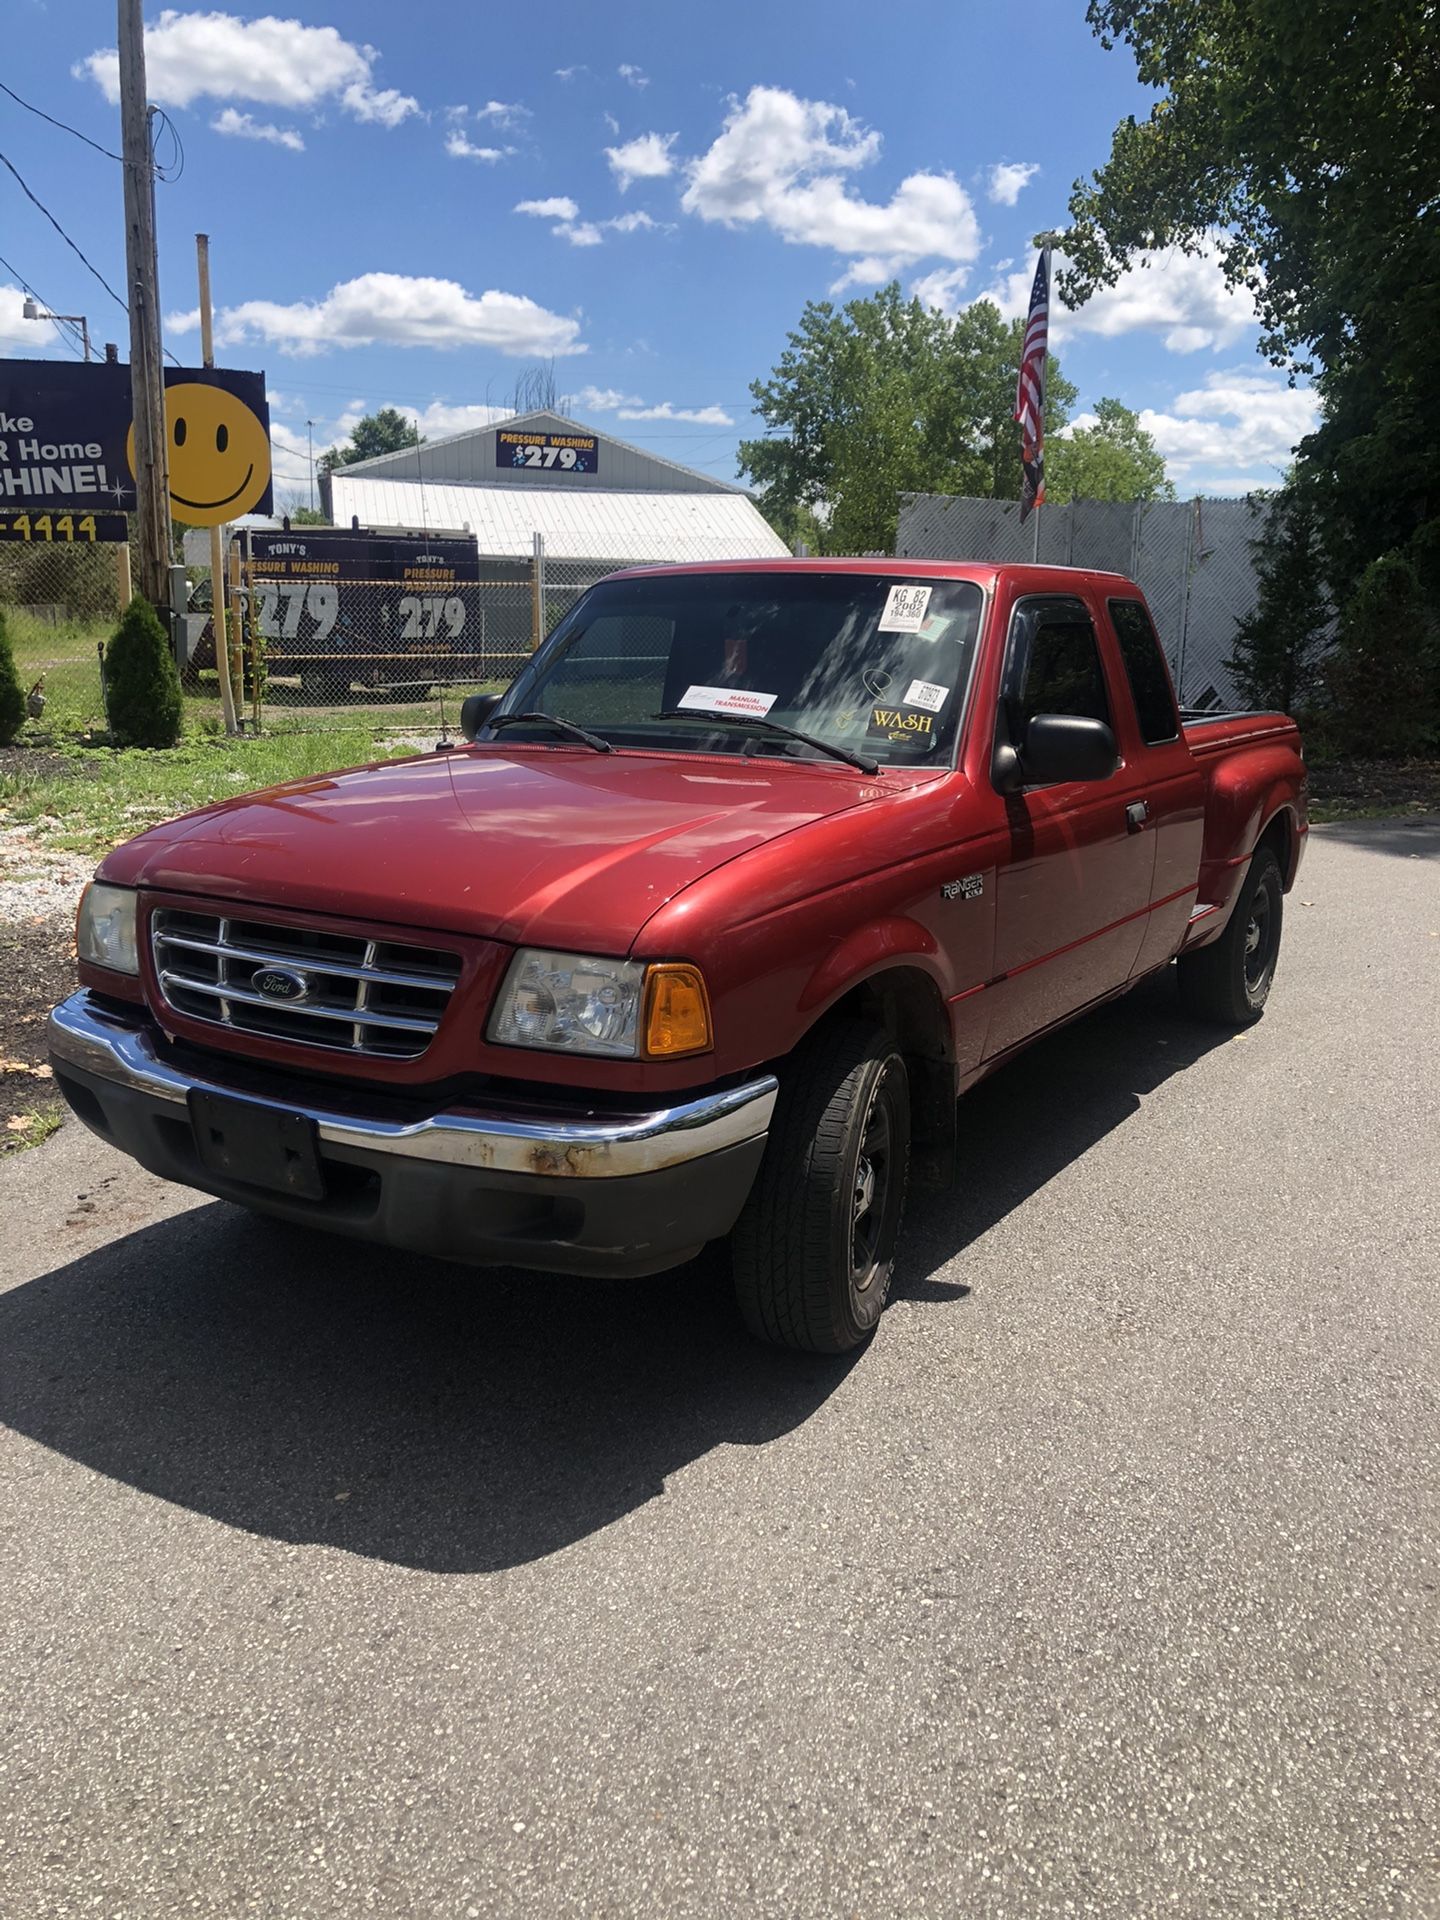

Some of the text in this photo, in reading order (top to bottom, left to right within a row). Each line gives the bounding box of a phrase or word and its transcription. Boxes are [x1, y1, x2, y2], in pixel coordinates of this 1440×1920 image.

[0, 412, 34, 432] ke
[501, 433, 594, 449] PRESSURE WASHING
[19, 438, 102, 461] Home
[516, 445, 577, 469] $279
[0, 465, 109, 496] HINE!
[268, 543, 306, 556] TONY'S
[291, 561, 339, 573] WASHING
[404, 568, 455, 579] PRESSURE
[893, 588, 927, 604] KG 82
[894, 602, 924, 611] 2002
[715, 699, 768, 712] TRANSMISSION
[729, 695, 760, 704] MANUAL
[874, 709, 933, 733] WASH
[263, 974, 292, 994] Ford
